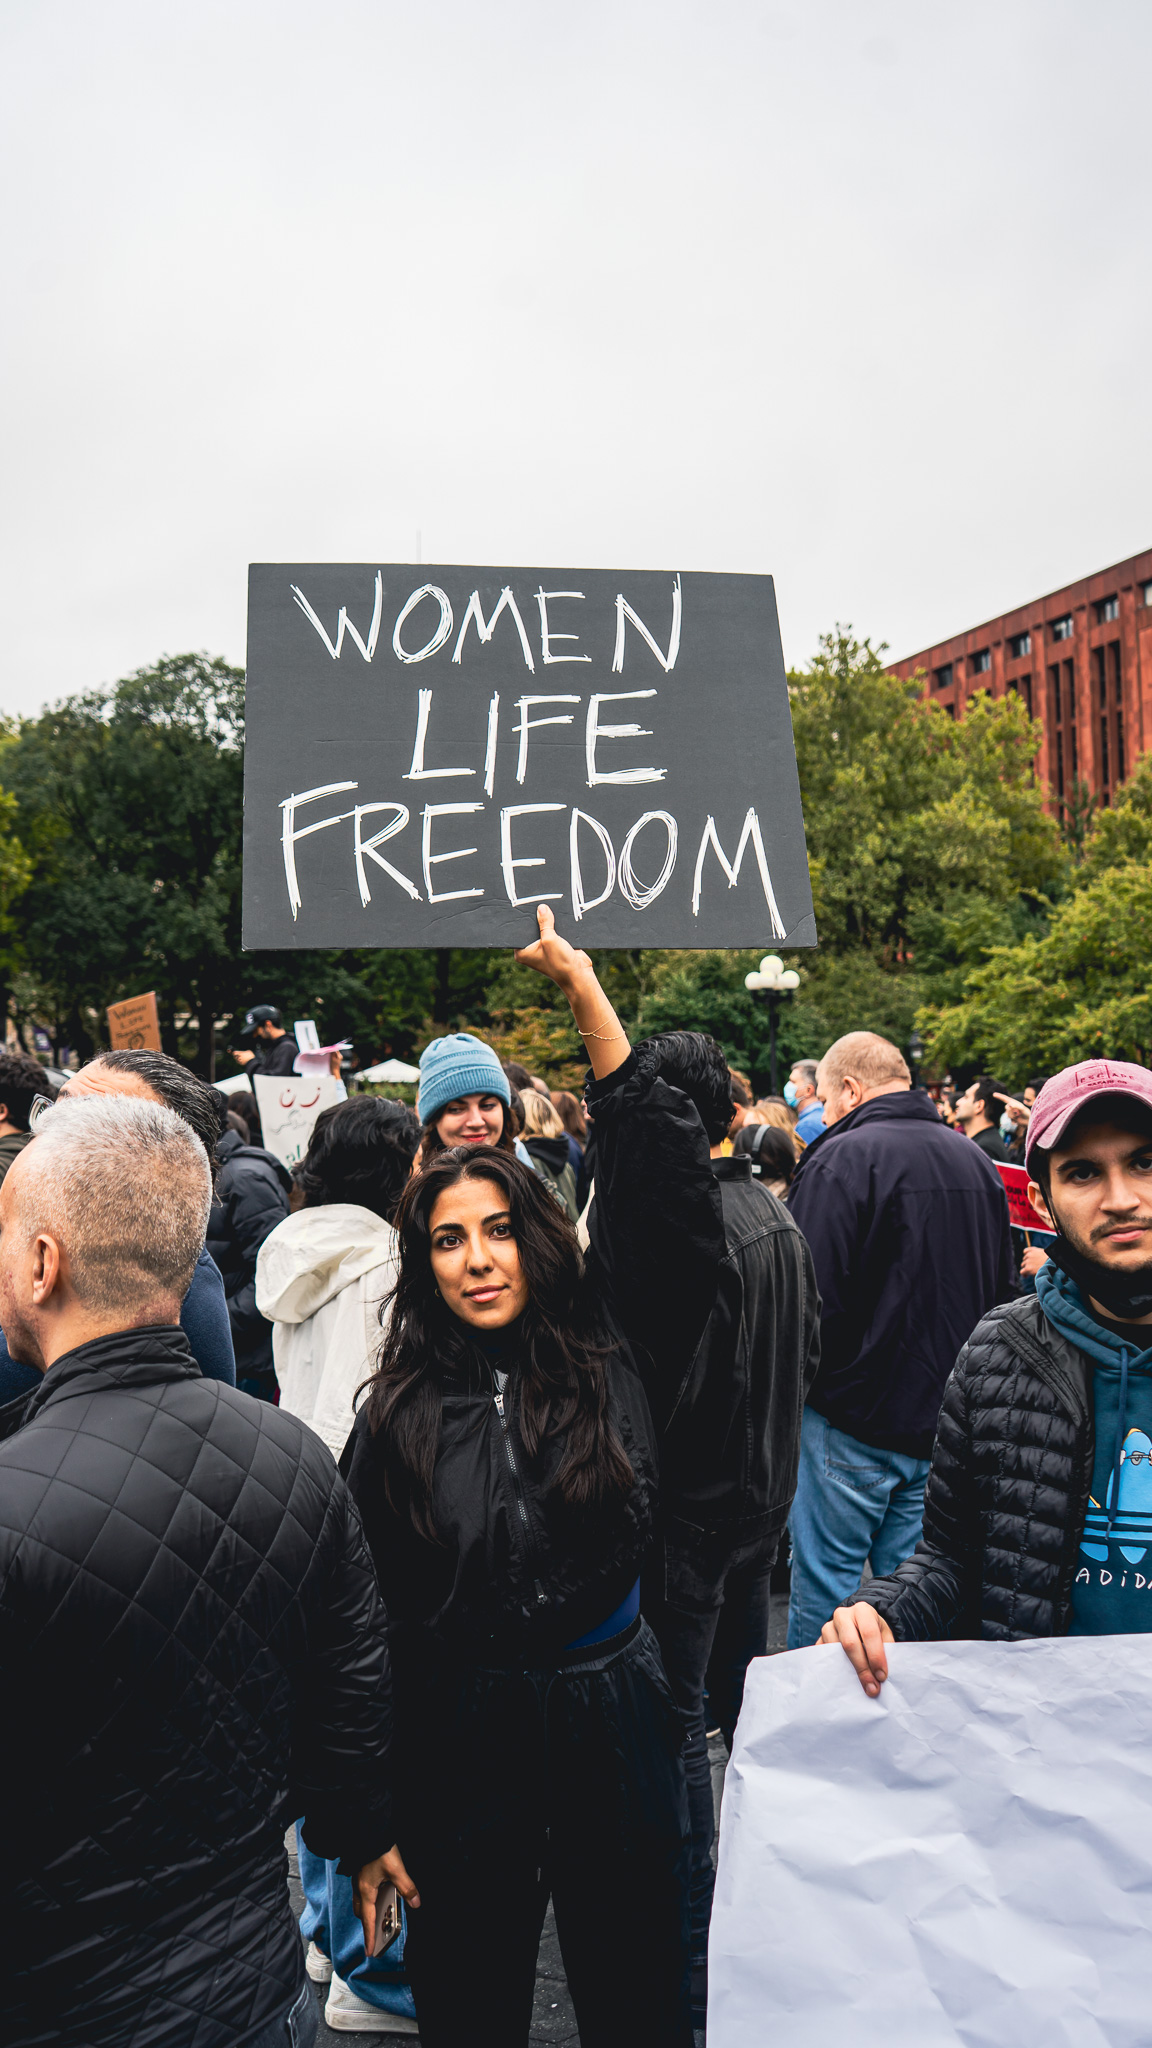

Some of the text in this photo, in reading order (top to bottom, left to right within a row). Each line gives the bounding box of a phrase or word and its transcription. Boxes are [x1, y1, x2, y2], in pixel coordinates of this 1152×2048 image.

[290, 569, 682, 674] WOMEN
[402, 688, 668, 798] LIFE
[279, 780, 787, 941] FREEDOM
[279, 1086, 321, 1109] زن
